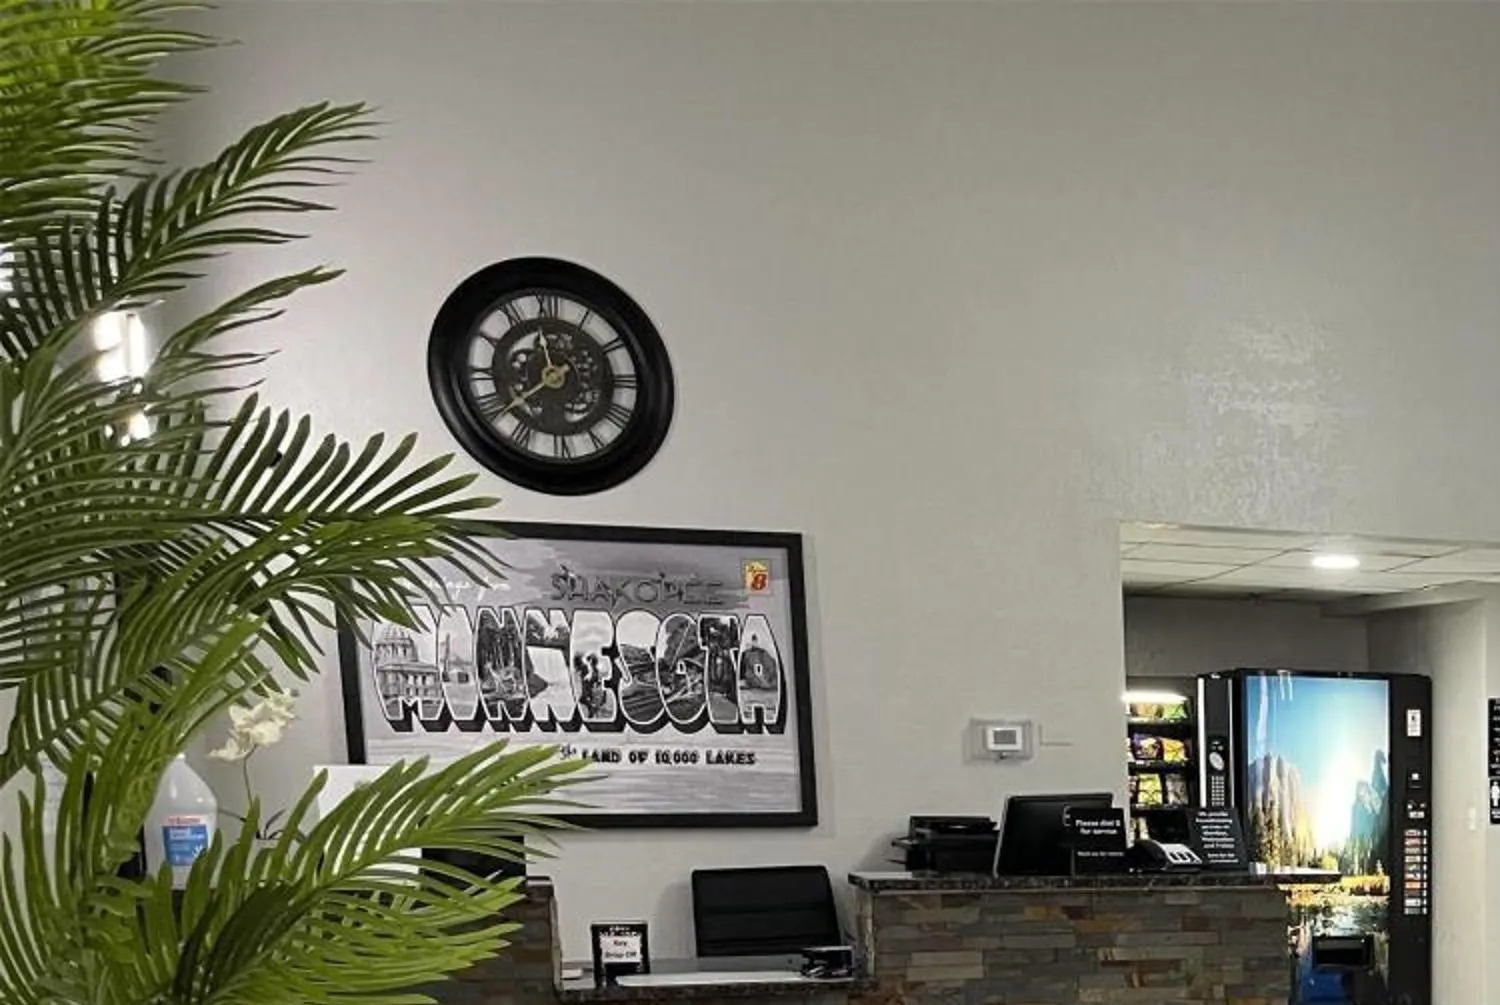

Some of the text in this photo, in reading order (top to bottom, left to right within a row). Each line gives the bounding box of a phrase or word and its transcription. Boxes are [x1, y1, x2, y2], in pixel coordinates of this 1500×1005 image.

[371, 604, 788, 735] MINNESOTA
[582, 750, 621, 764] LAND
[629, 750, 649, 764] OF
[655, 750, 698, 766] 10,000
[705, 750, 756, 765] LAKES
